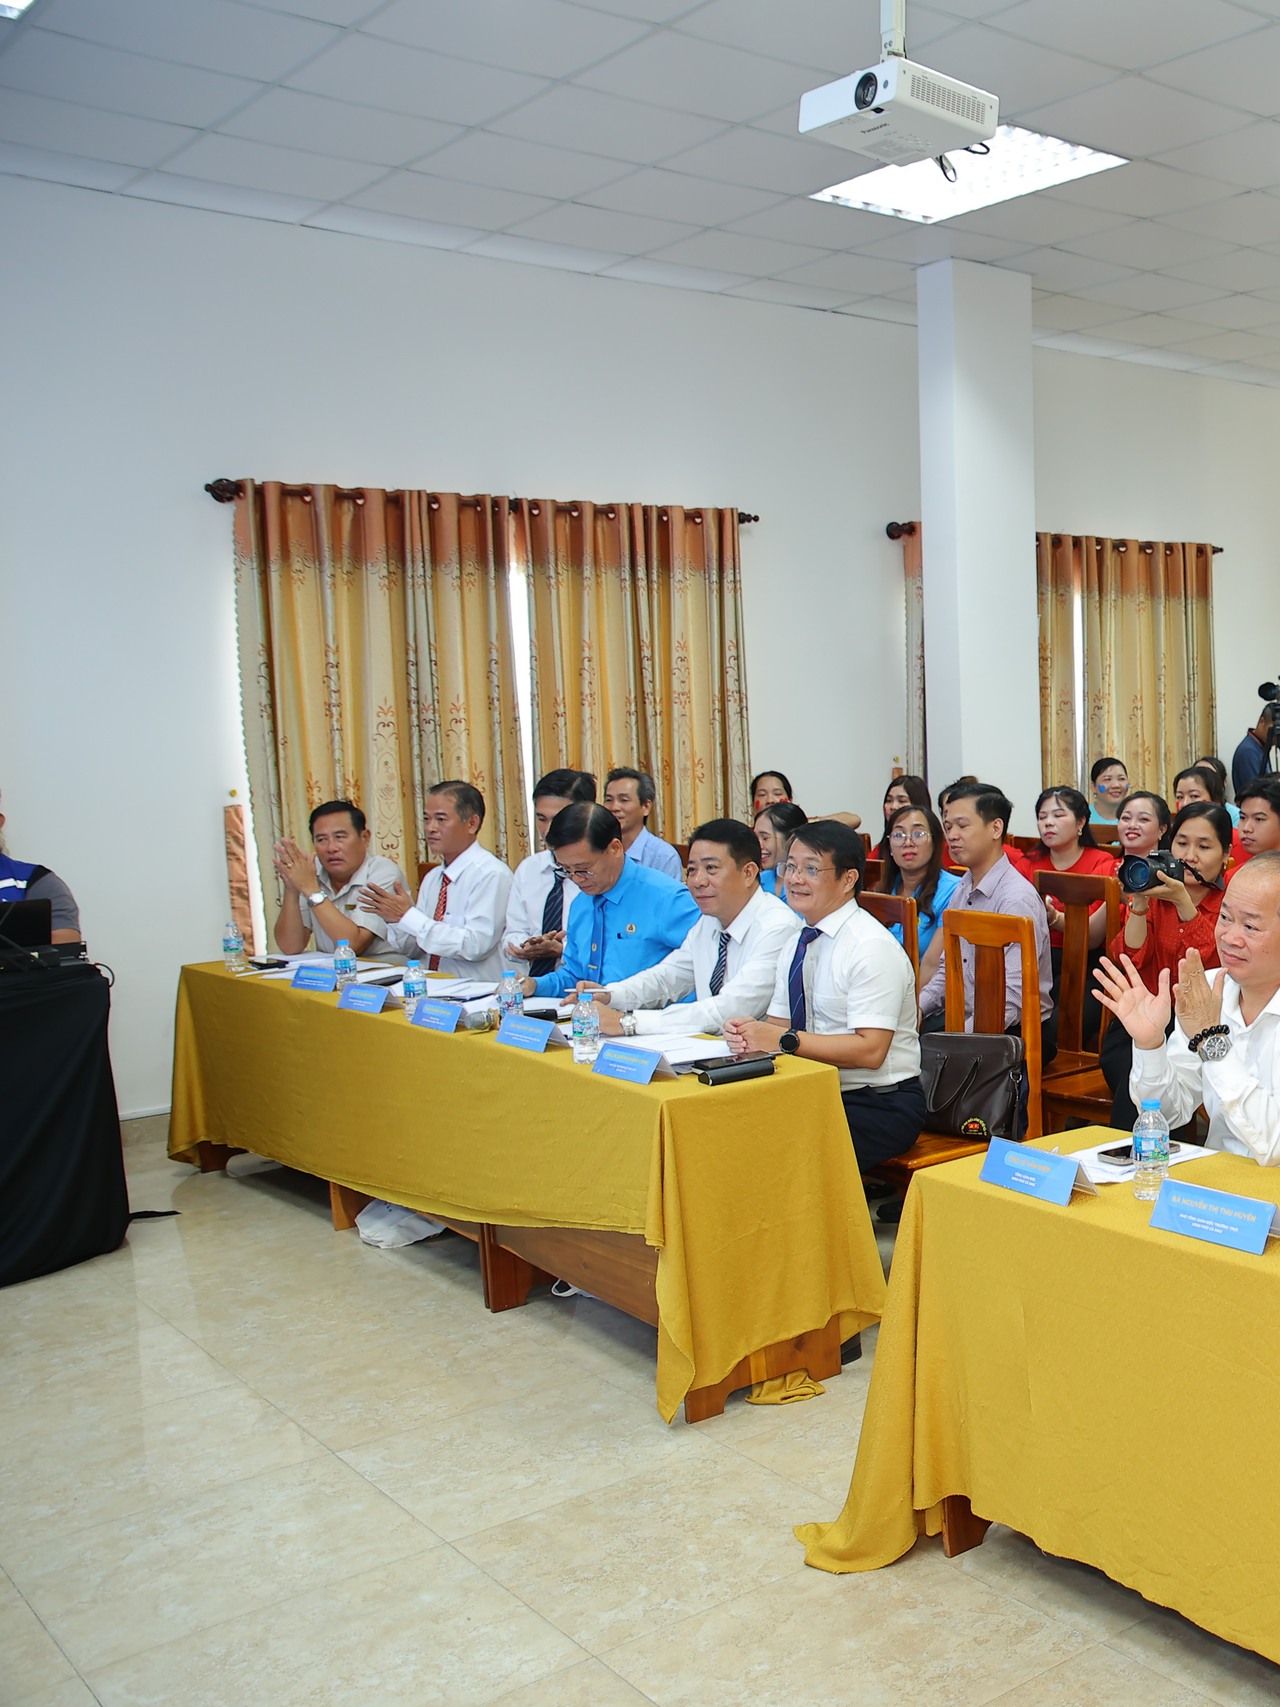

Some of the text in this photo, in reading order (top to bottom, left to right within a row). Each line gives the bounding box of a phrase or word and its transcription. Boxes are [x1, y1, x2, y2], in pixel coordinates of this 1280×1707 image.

[1182, 1197, 1207, 1210] NGUYỄN
[1209, 1203, 1219, 1213] THỊ
[1221, 1206, 1232, 1216] THU
